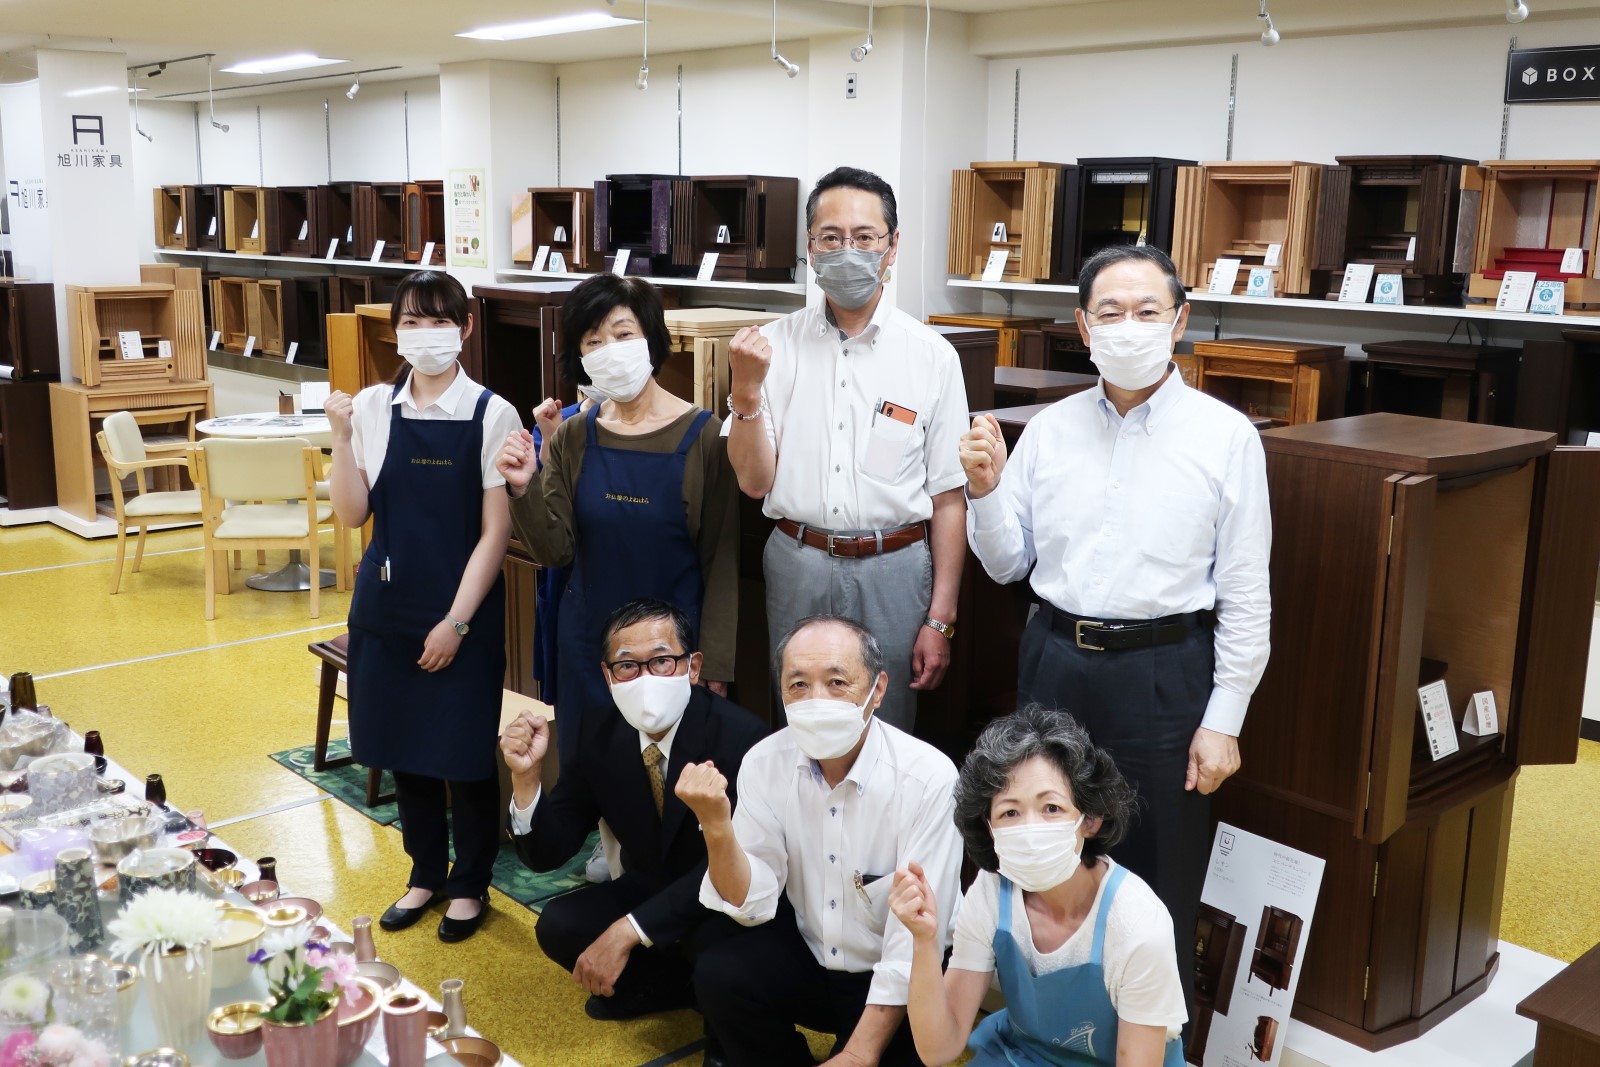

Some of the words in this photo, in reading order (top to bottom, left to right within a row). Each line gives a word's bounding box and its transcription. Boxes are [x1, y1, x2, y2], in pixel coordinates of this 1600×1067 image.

[1546, 66, 1596, 82] BOX
[57, 153, 123, 168] 旭川家具
[21, 188, 49, 209] 旭川家
